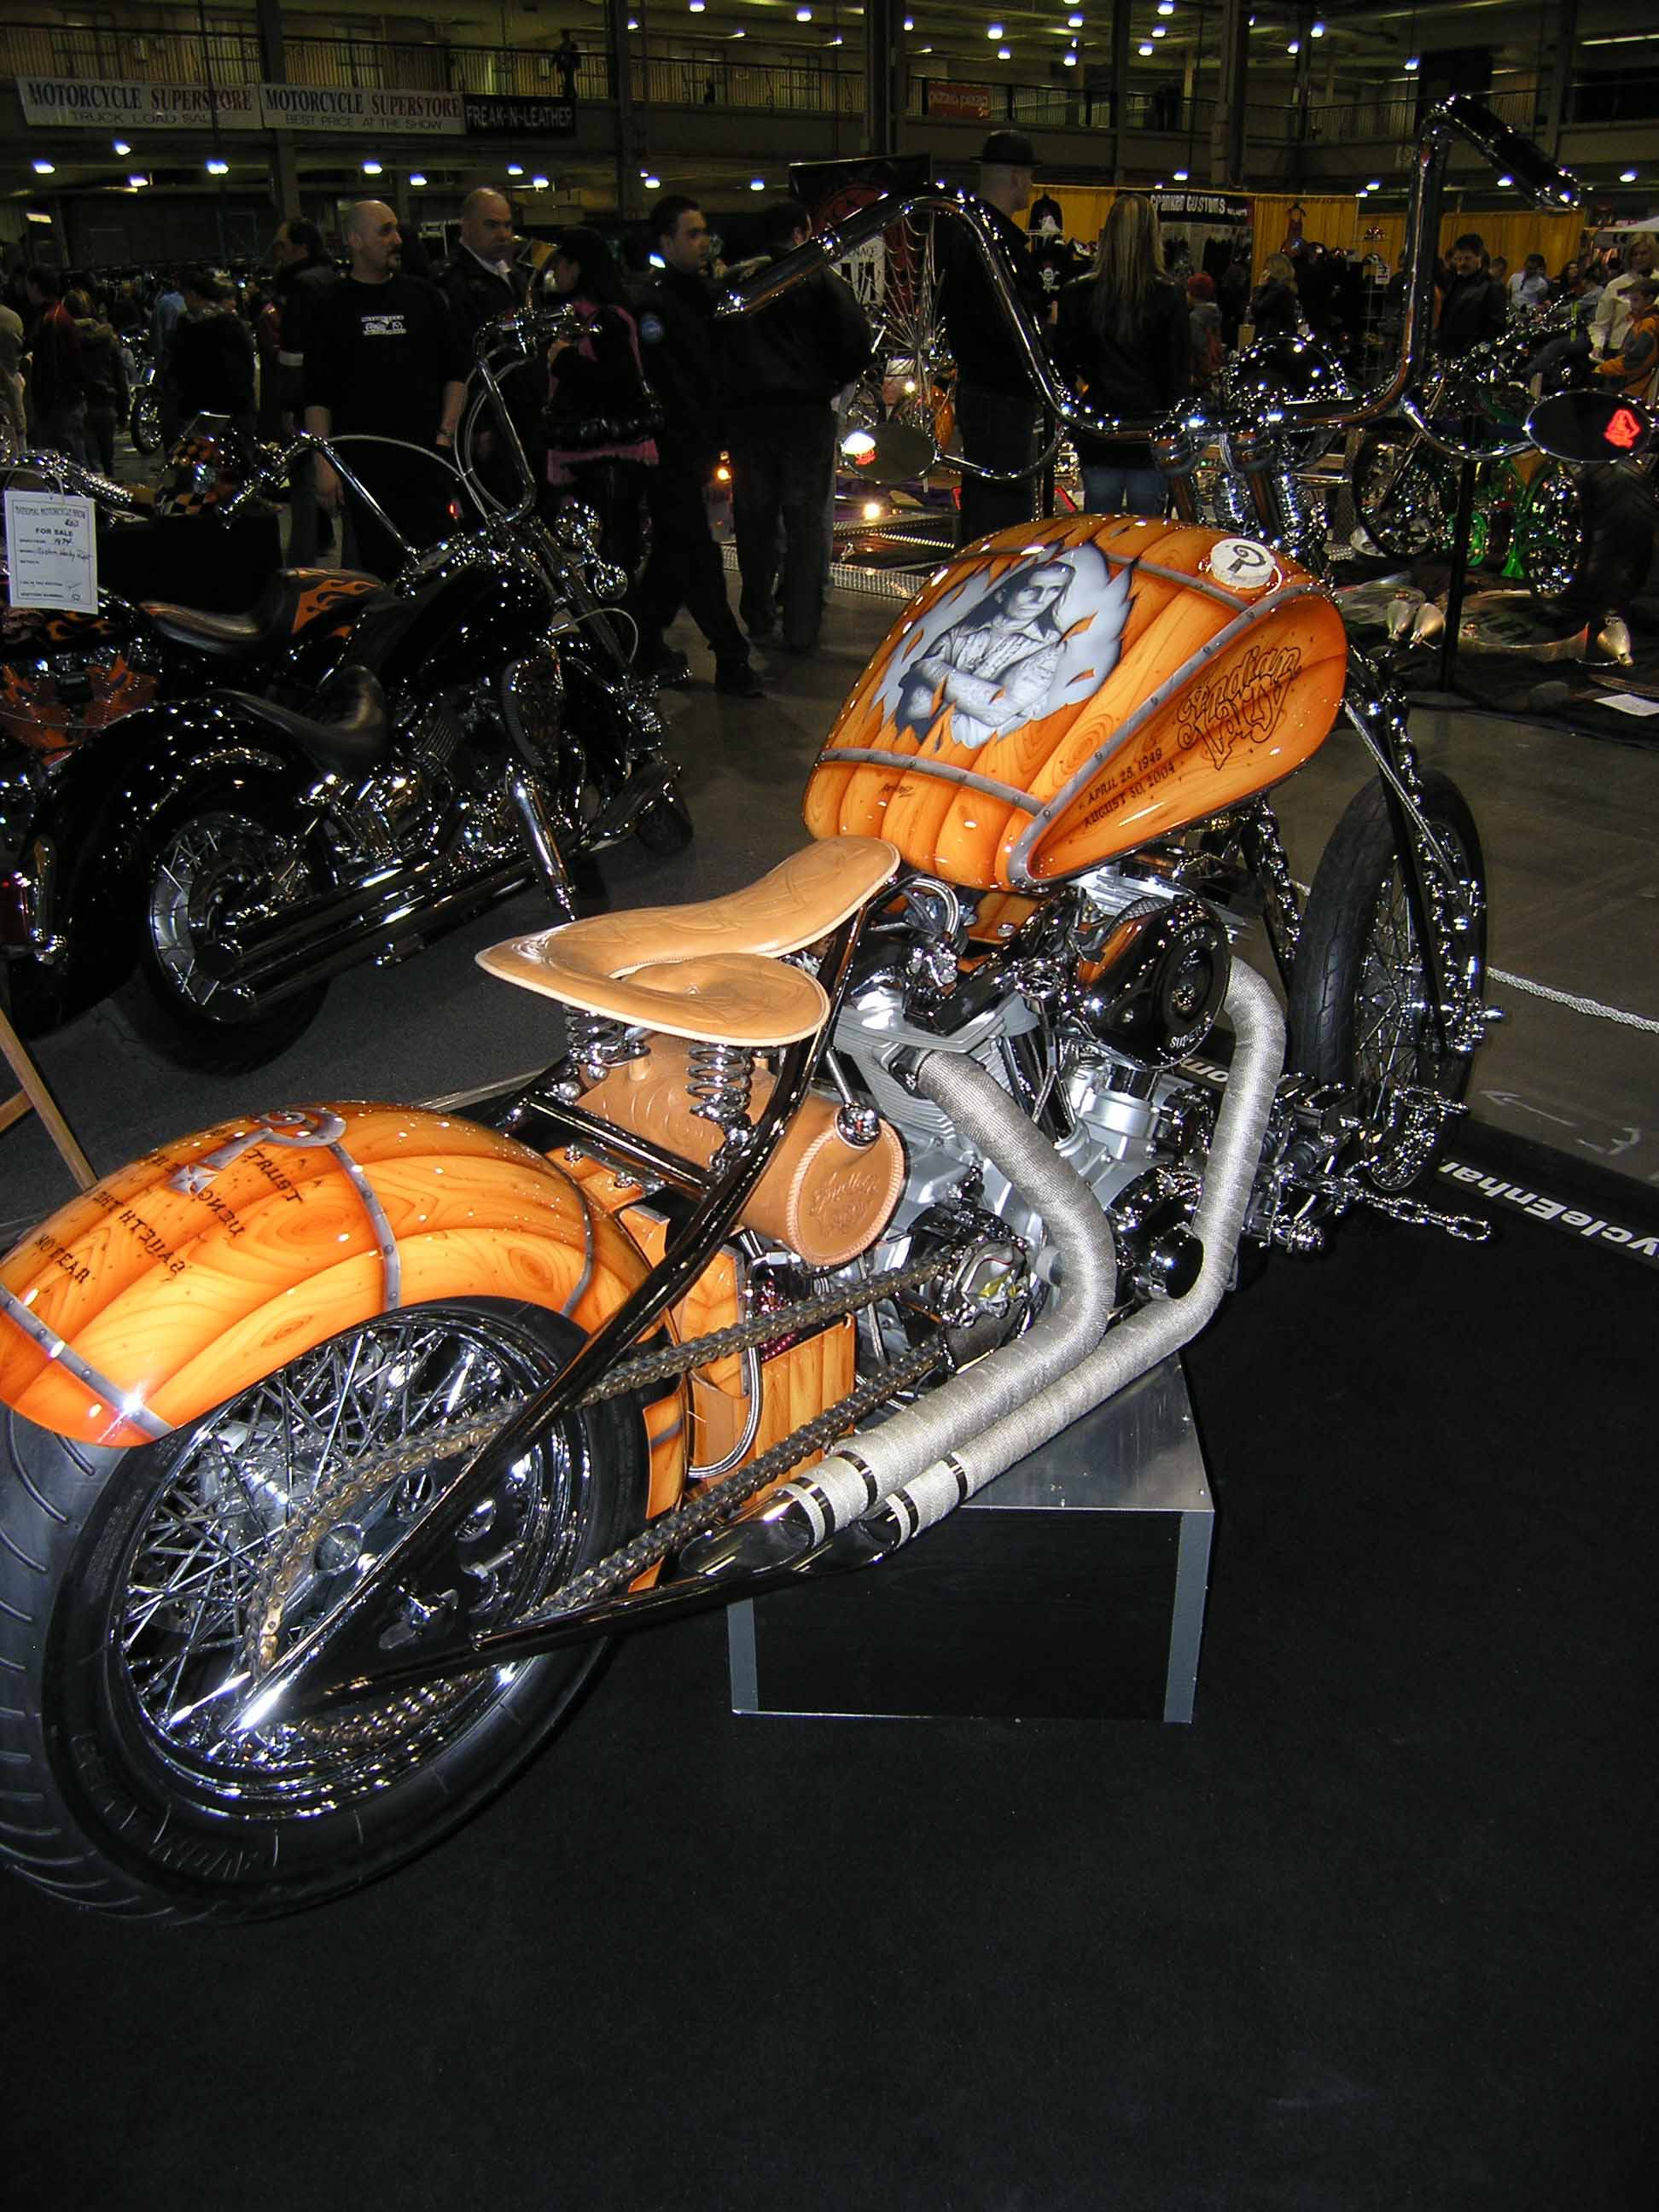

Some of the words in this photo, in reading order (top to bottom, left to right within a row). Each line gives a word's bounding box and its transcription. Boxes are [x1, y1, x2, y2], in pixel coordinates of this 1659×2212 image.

[27, 81, 143, 110] MOTORCYCLE
[151, 87, 253, 111] SUPERSTORE
[265, 89, 364, 114] MOTORCYCLE
[371, 95, 461, 118] SUPERSTORE
[73, 111, 124, 124] TRUCK
[131, 112, 178, 124] LOAD
[286, 114, 316, 125] BEST
[321, 115, 355, 127] PRICE
[381, 118, 404, 129] THE
[406, 119, 444, 130] SHOW
[36, 527, 52, 536] FOR
[54, 528, 74, 538] SALE
[1084, 791, 1127, 828] AUGUST
[1147, 760, 1175, 788] 2004
[1088, 777, 1120, 805] APRIL
[245, 1148, 304, 1205] TRUST
[1438, 1161, 1659, 1257] ycleEnha
[36, 1234, 56, 1252] NO
[50, 1248, 92, 1284] FEAR
